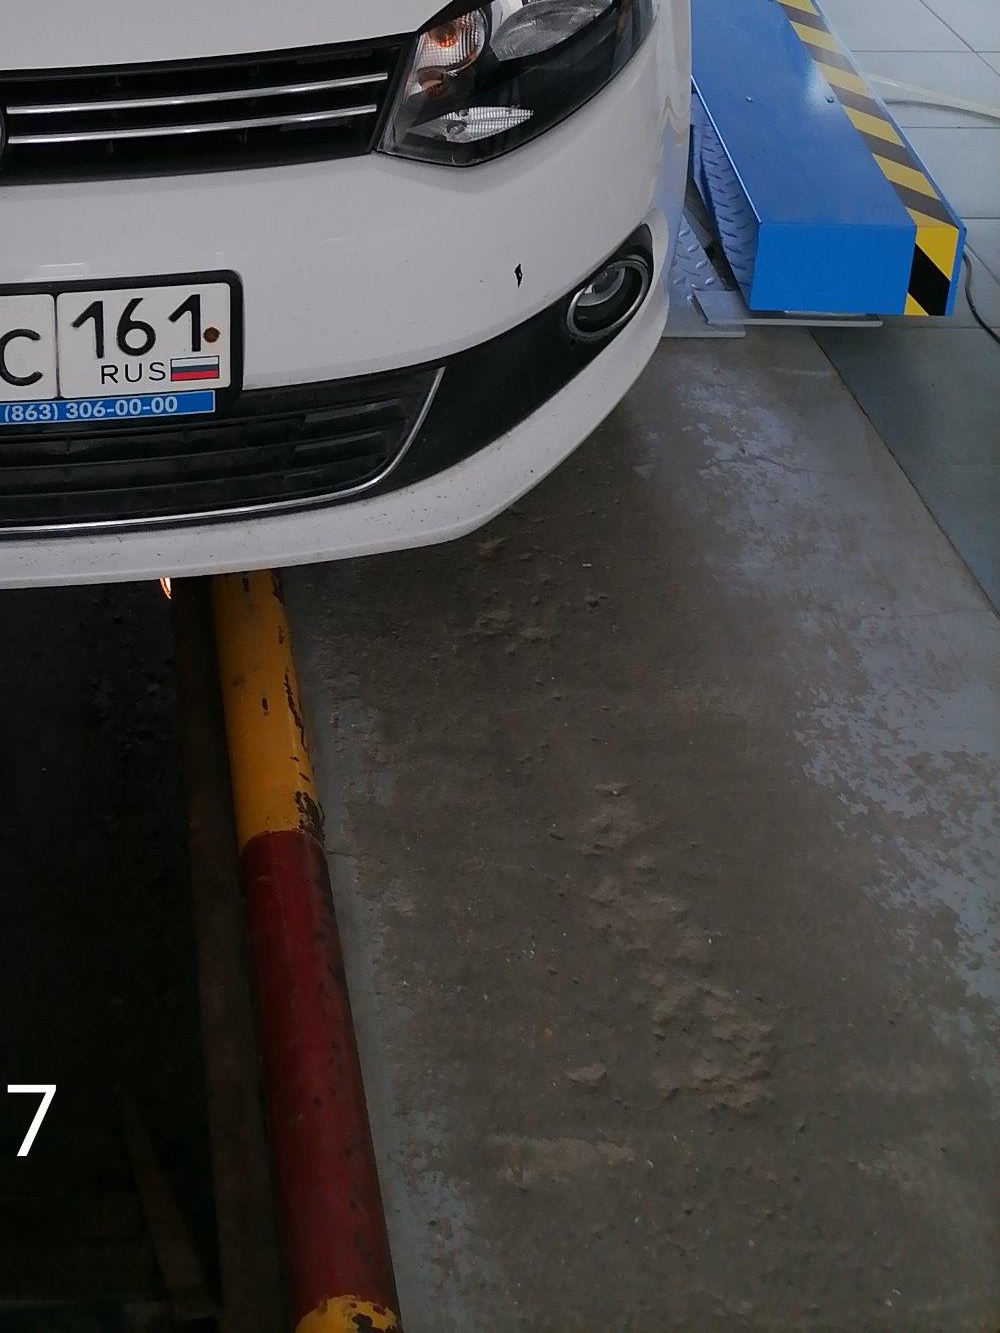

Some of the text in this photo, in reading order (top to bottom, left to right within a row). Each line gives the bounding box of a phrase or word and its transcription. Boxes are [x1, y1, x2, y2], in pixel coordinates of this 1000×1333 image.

[71, 294, 202, 359] 161
[100, 361, 166, 385] RUS
[4, 403, 59, 423] (863)
[65, 396, 178, 419] 306-00-00
